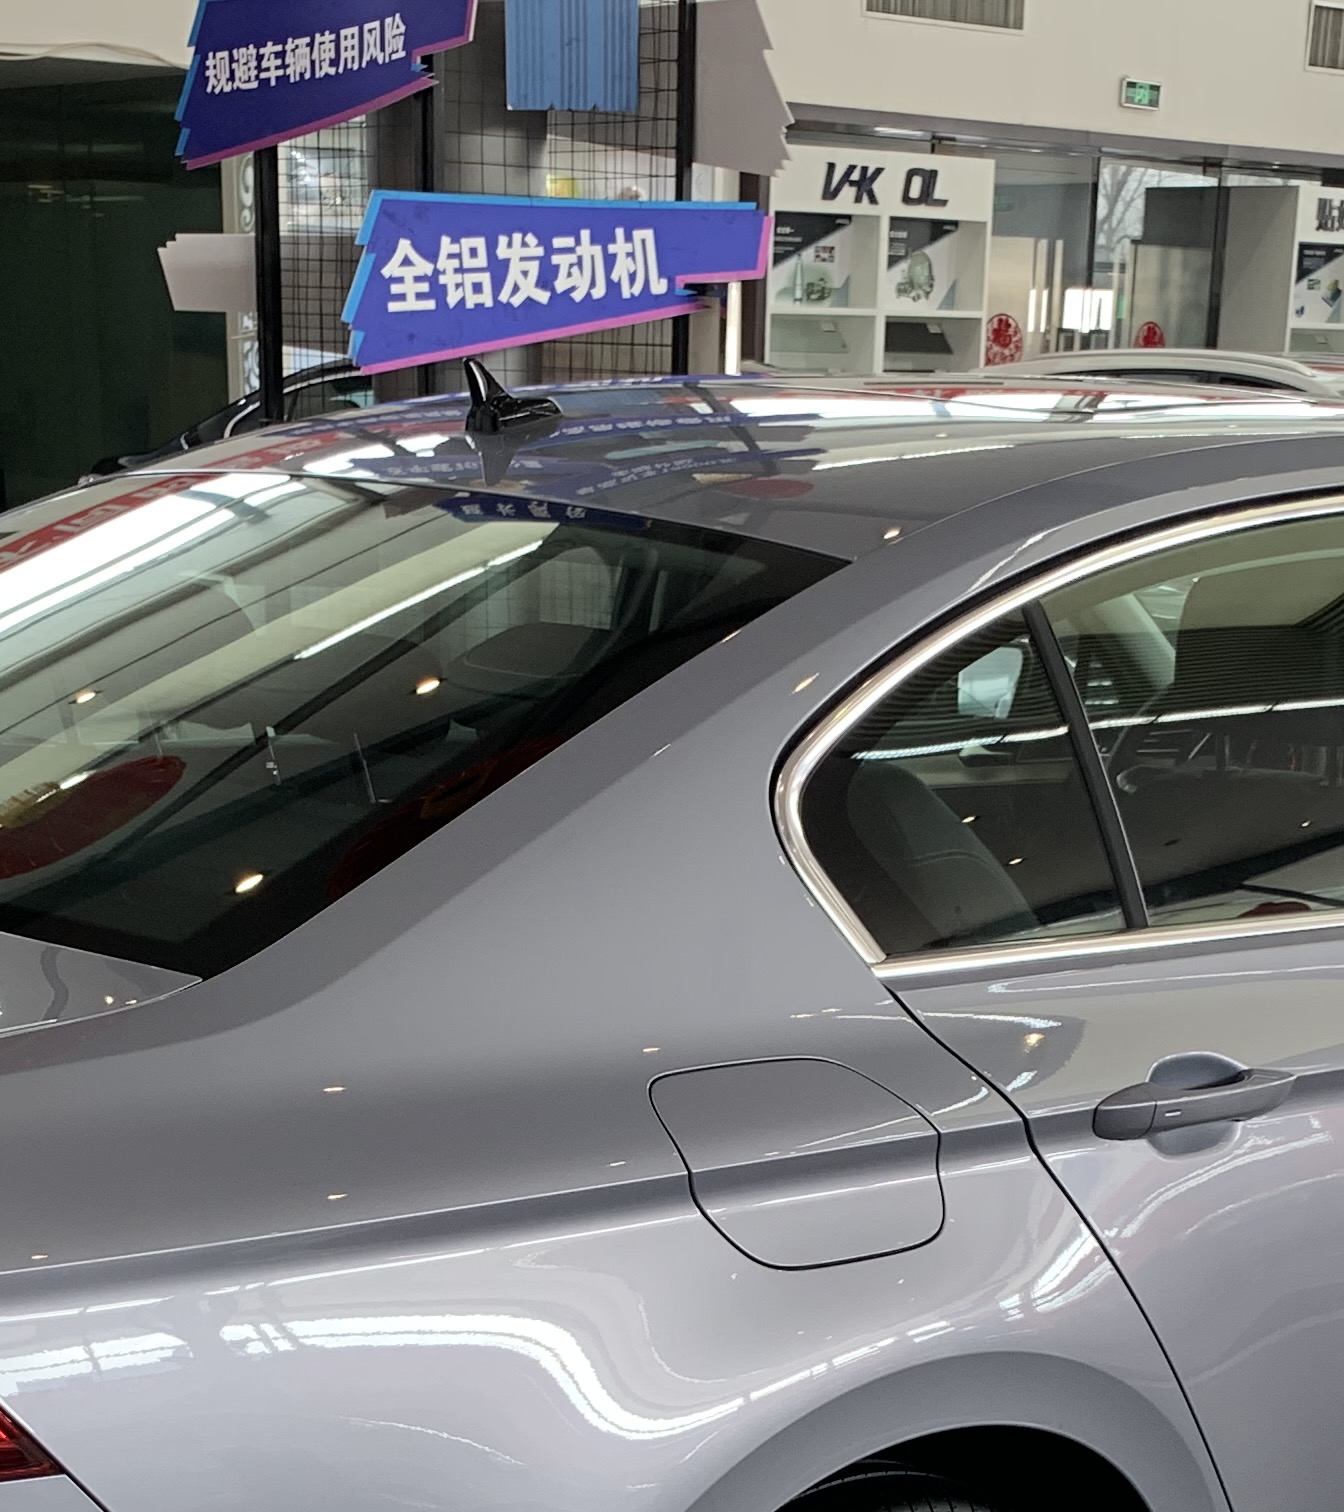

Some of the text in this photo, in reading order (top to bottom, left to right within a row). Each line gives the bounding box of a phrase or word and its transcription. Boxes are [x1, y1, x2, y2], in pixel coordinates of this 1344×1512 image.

[205, 14, 407, 94] 规避车辆使用风险
[380, 227, 668, 313] 全铝发动机
